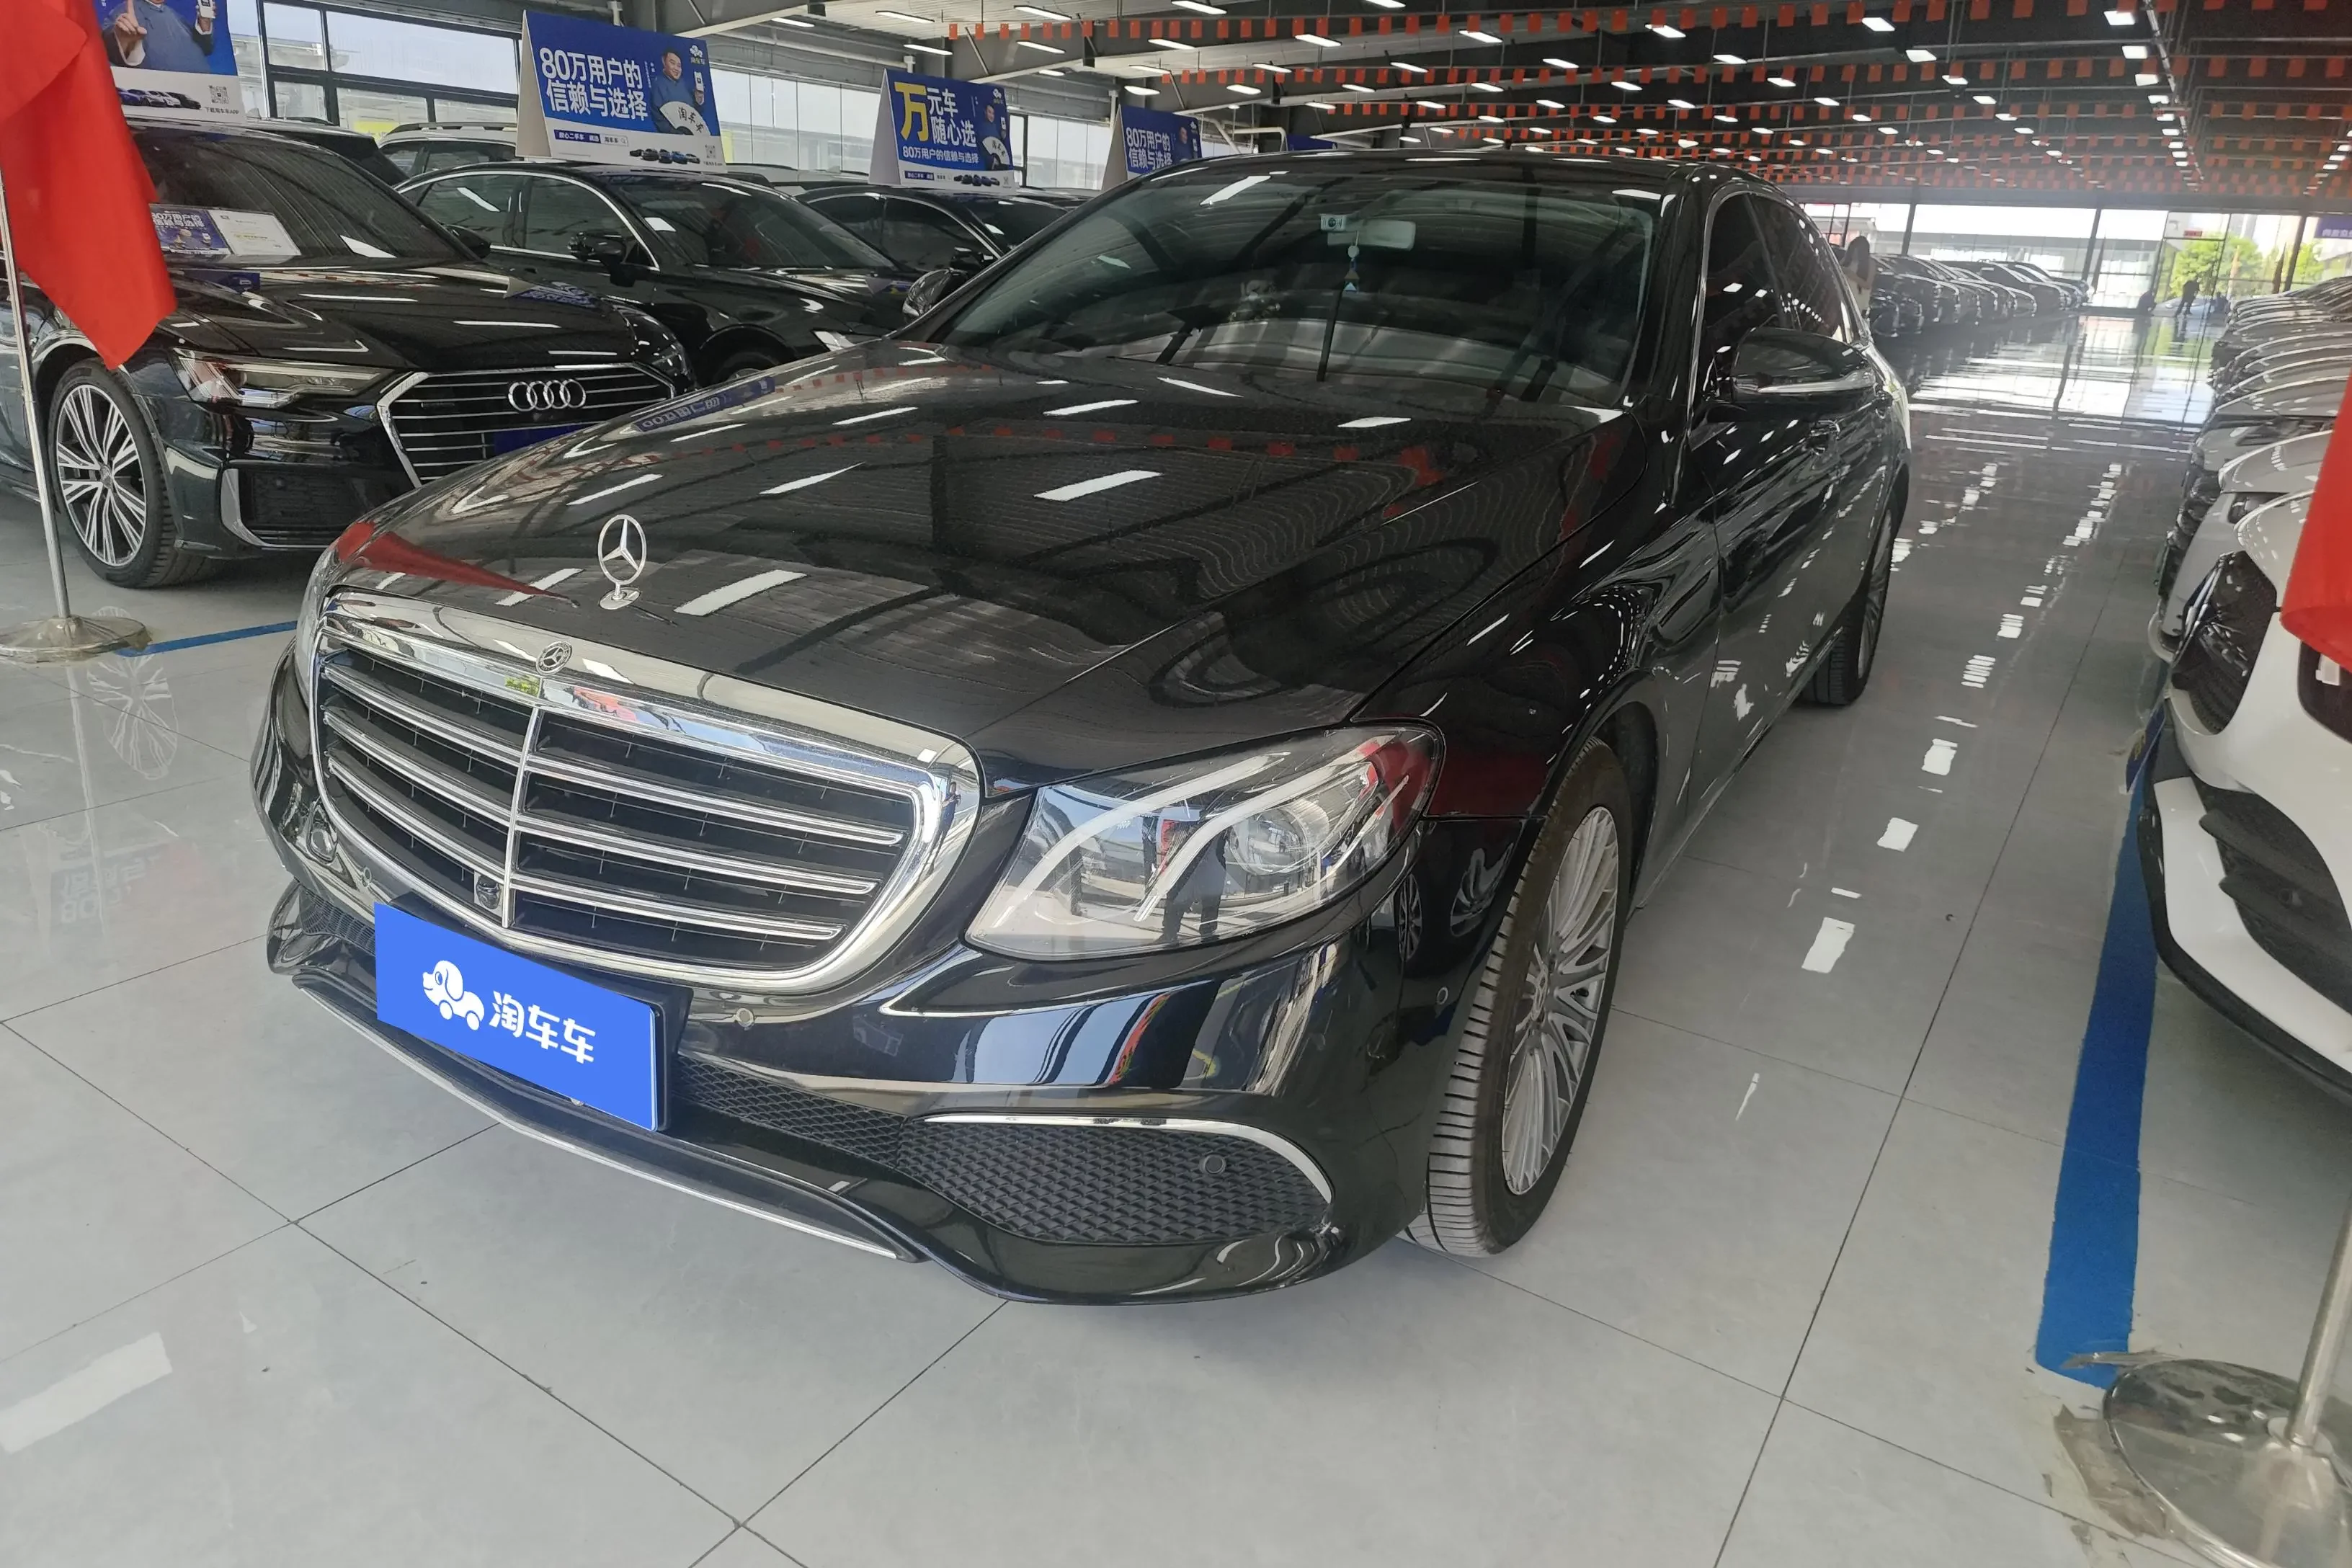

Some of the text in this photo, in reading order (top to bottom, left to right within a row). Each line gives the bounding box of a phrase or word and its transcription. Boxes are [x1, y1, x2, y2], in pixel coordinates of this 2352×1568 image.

[540, 47, 643, 89] 80万用户的
[546, 79, 649, 122] 信赖与选择
[894, 81, 929, 142] 万
[927, 88, 958, 118] 元车
[930, 116, 977, 148] 随心选
[1126, 127, 1171, 152] 80万用户的
[903, 146, 979, 164] 80万用户的信赖与选择
